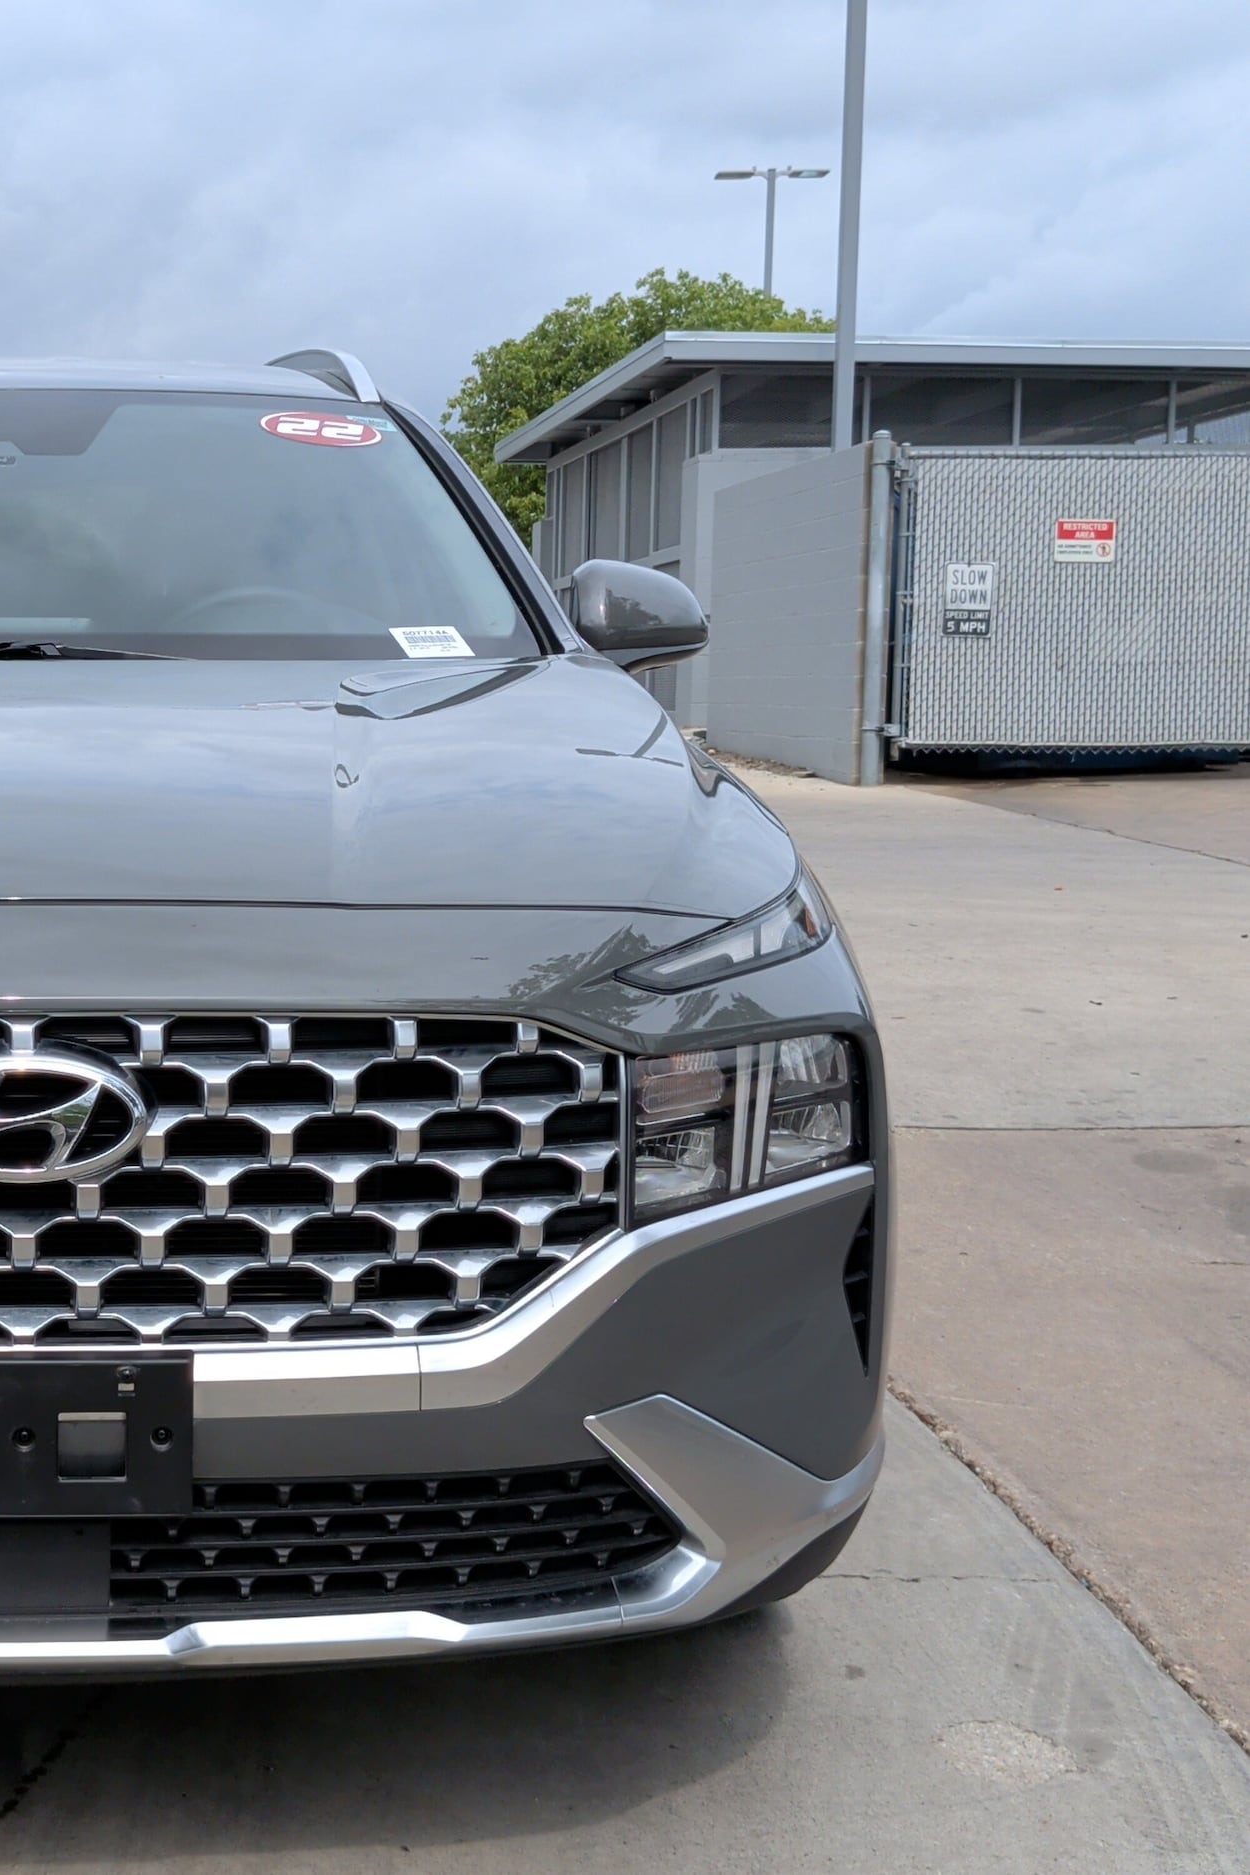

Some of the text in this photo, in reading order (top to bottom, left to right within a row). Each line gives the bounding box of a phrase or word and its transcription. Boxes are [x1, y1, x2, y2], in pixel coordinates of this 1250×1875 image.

[276, 416, 365, 441] 22
[1063, 523, 1108, 531] RESTRICTED
[1074, 531, 1095, 539] AREA
[952, 569, 988, 585] SLOW
[950, 589, 987, 604] DOWN
[945, 611, 990, 619] SPEED LIMIT
[946, 621, 986, 633] 5 MPH
